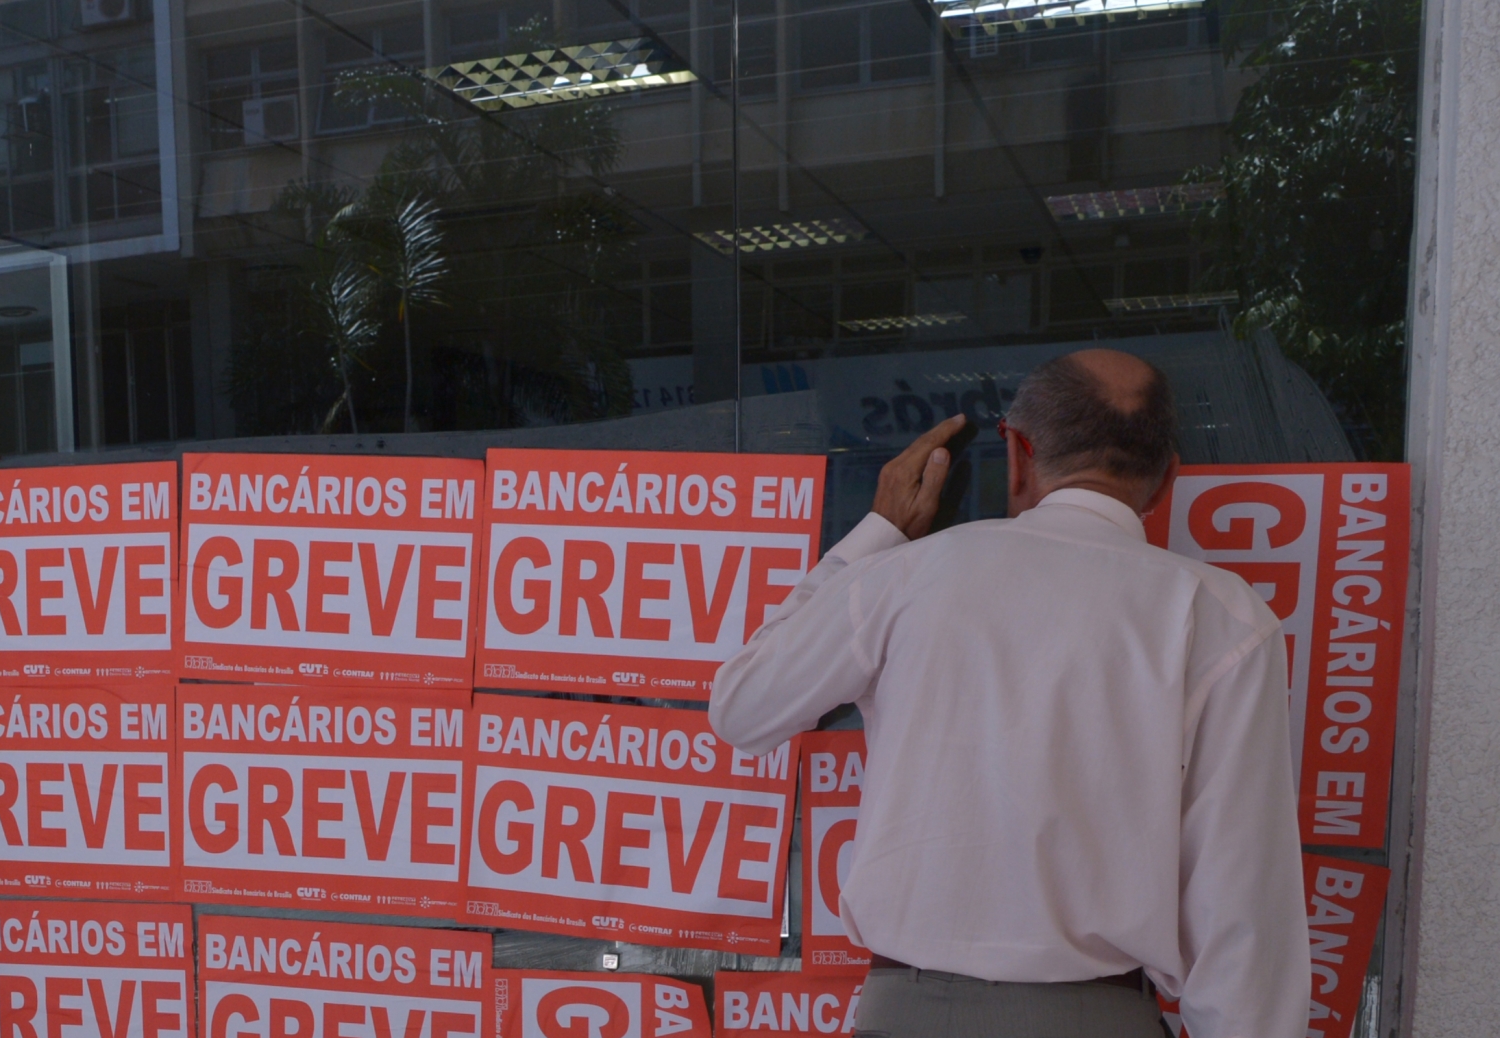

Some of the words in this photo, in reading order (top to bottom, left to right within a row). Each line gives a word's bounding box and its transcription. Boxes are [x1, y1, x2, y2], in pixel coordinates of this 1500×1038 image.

[122, 482, 169, 520] EM
[190, 466, 406, 516] BANCÁRIOS
[421, 479, 474, 519] EM
[493, 463, 736, 516] BANCÁRIOS
[752, 477, 813, 519] EM
[192, 536, 466, 640] GREVE
[1322, 474, 1390, 753] BANCÁRIOS
[23, 665, 44, 675] CUT
[299, 663, 323, 675] CUT
[612, 672, 638, 683] CUT
[121, 704, 166, 739] EM
[184, 697, 396, 744] BANCÁRIOS
[411, 708, 463, 747] EM
[479, 714, 716, 772] BANCÁRIOS
[730, 740, 789, 780] EM
[189, 764, 456, 865] GREVE
[1314, 772, 1365, 834] EM
[478, 780, 778, 903] GREVE
[297, 887, 320, 898] CUT
[138, 922, 184, 957] EM
[592, 915, 618, 928] CUT
[206, 932, 416, 983] BANCÁRIOS
[431, 949, 482, 988] EM
[723, 986, 859, 1033] BANCÁ
